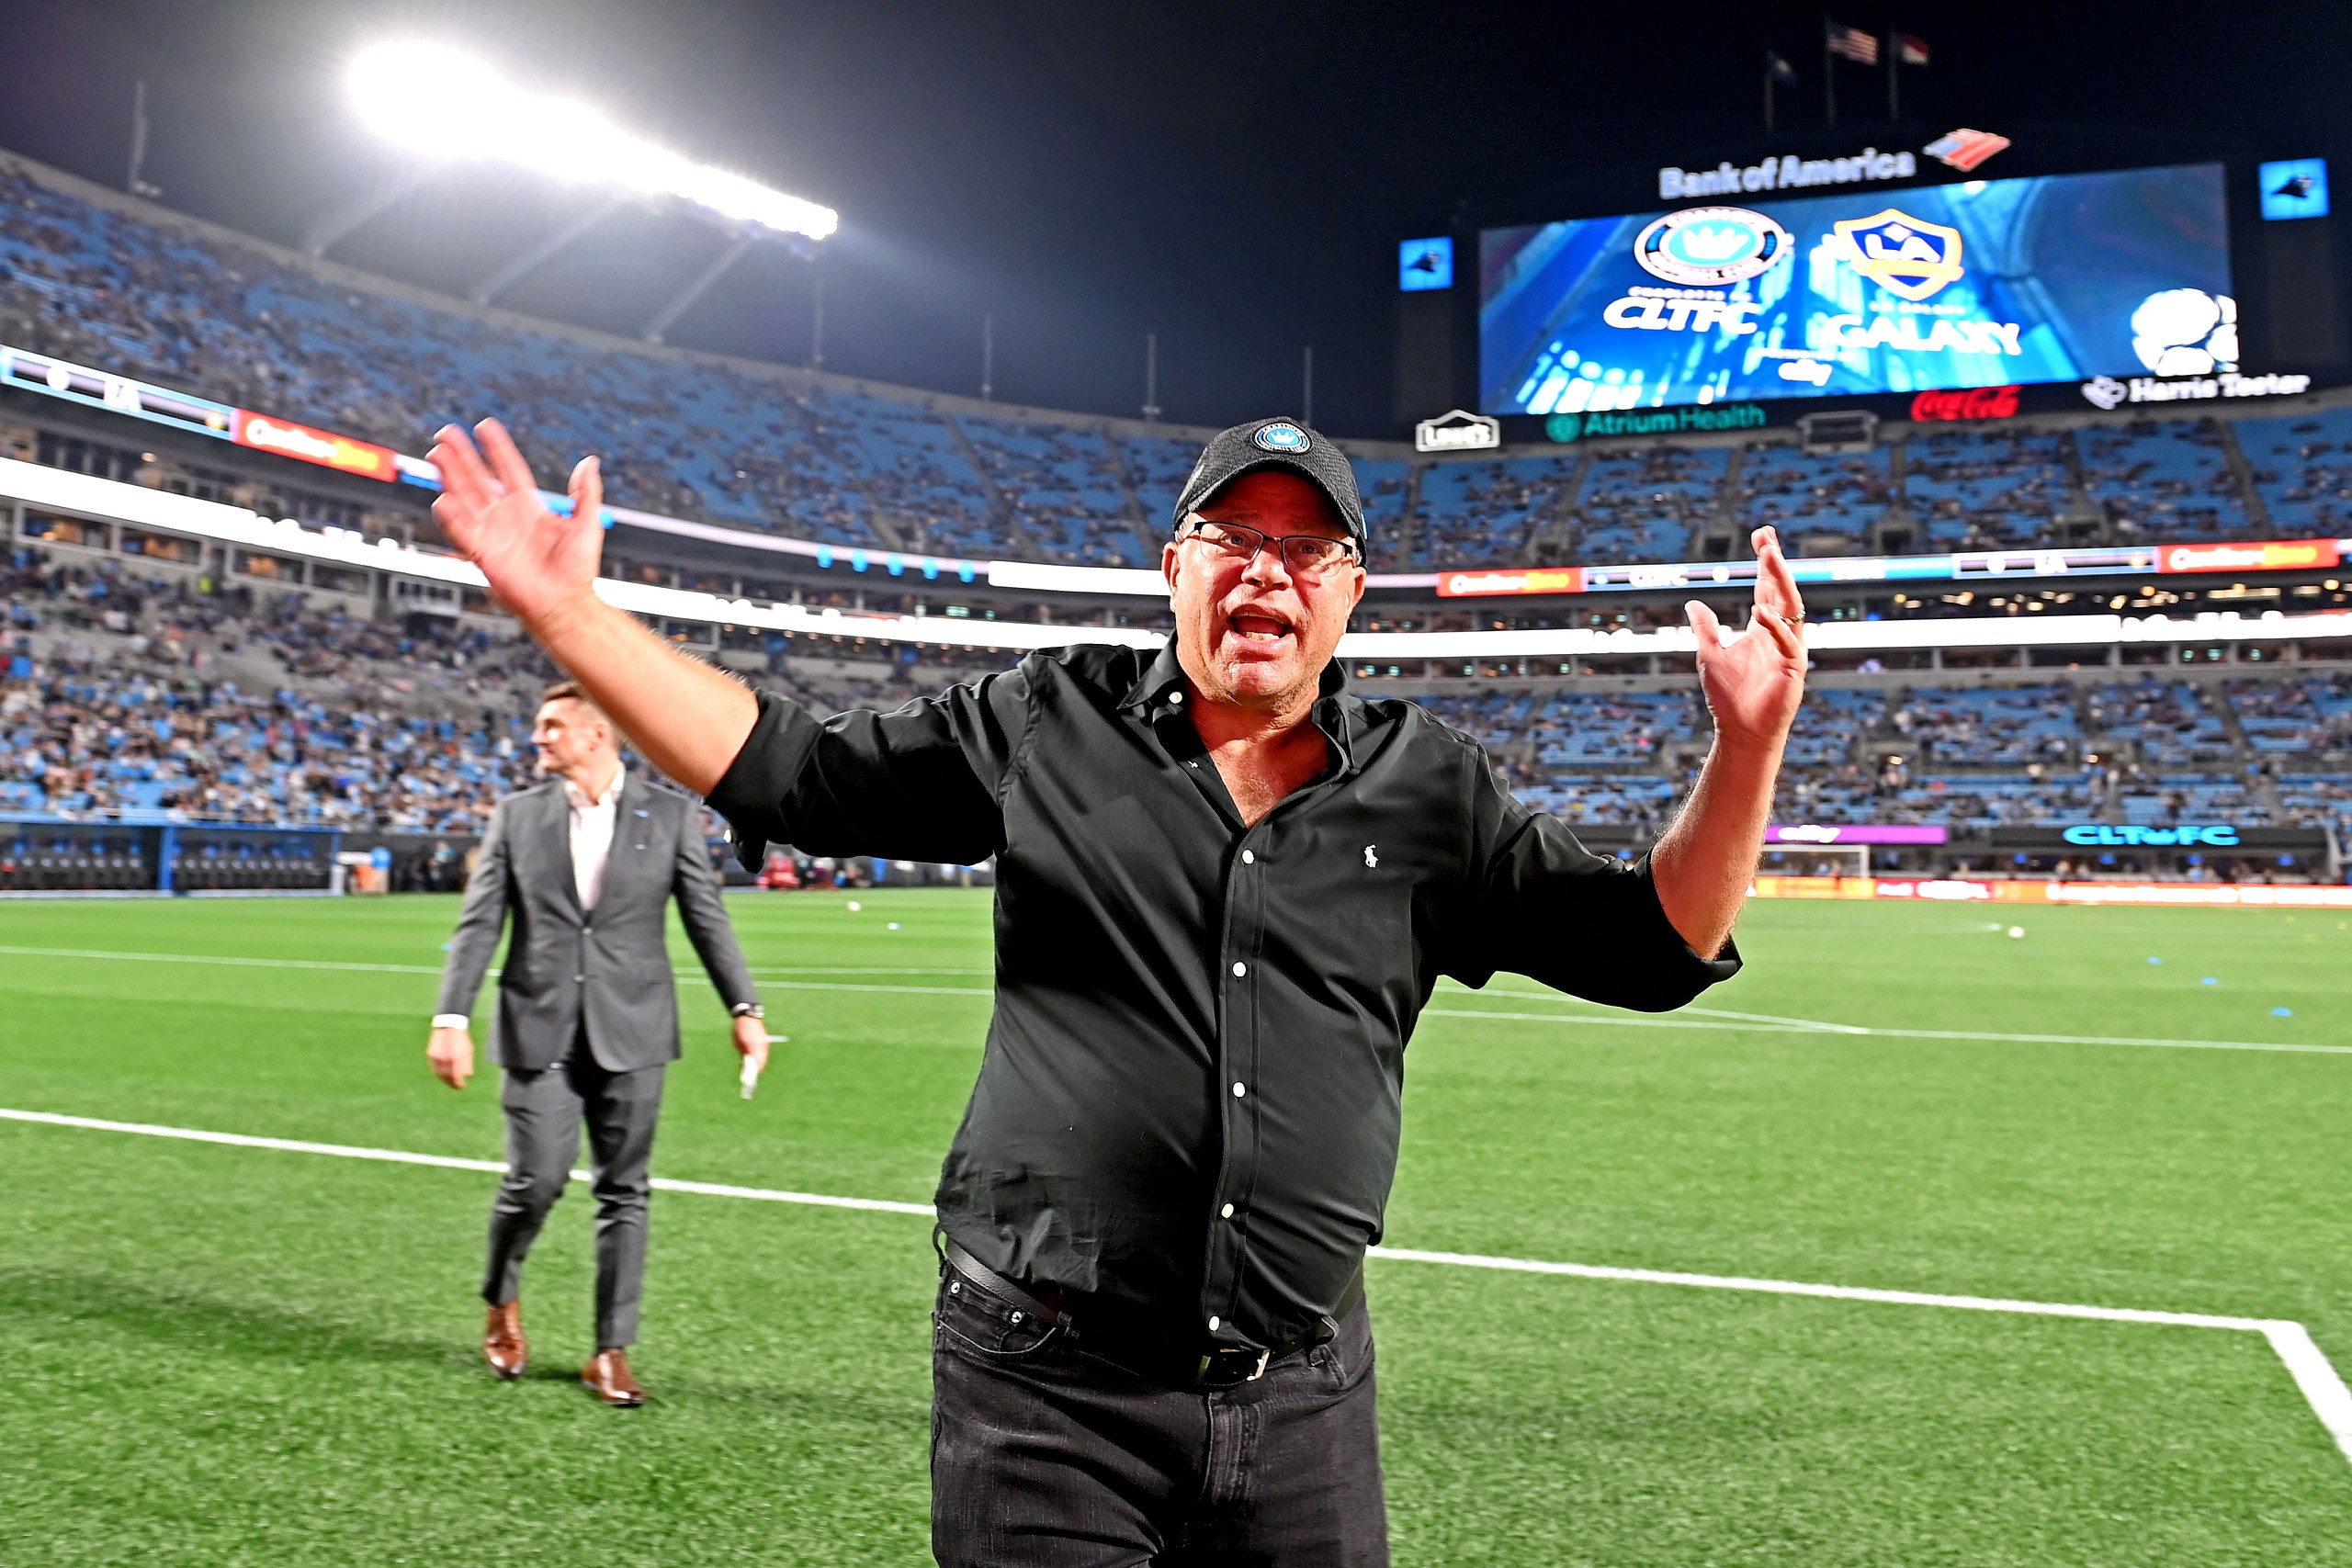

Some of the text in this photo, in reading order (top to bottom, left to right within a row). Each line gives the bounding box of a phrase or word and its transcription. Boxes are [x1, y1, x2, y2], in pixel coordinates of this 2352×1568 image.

[1658, 146, 1916, 200] Bank of America
[1823, 313, 2021, 355] GALAXY
[2128, 372, 2311, 402] Harris Teeter
[1583, 403, 1766, 436] Atrium Health
